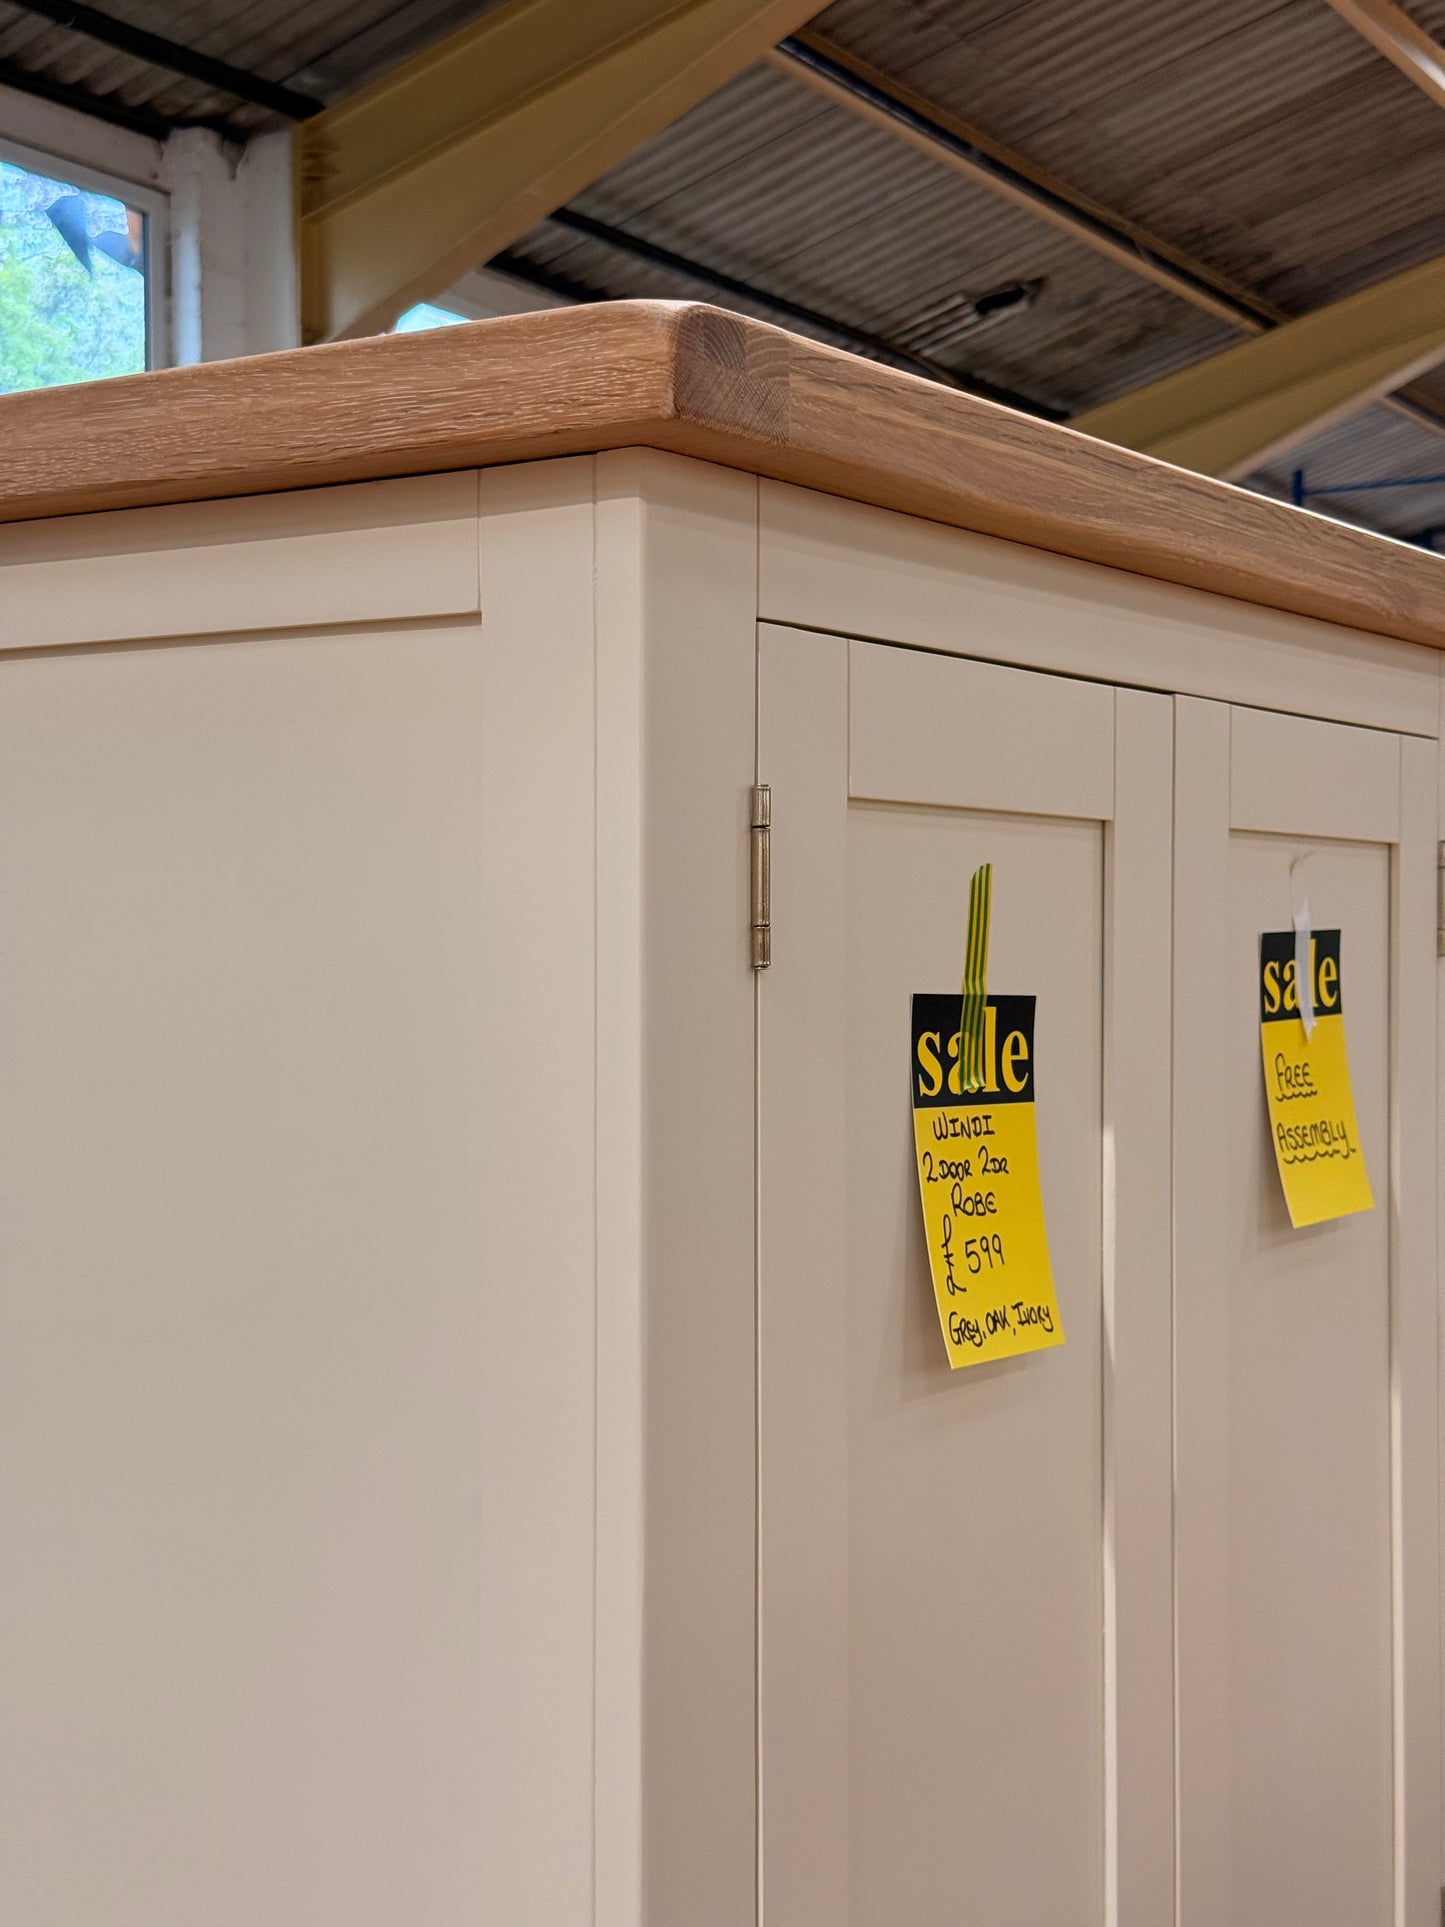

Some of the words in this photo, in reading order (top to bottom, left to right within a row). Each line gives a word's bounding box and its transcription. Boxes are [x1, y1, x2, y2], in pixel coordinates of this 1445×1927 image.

[1263, 938, 1338, 1014] sale
[917, 1006, 1029, 1097] sale
[1274, 1052, 1314, 1092] FREE
[932, 1111, 996, 1141] WINDI
[1276, 1119, 1352, 1159] ASSEMBLY
[951, 1182, 998, 1217] ROBE
